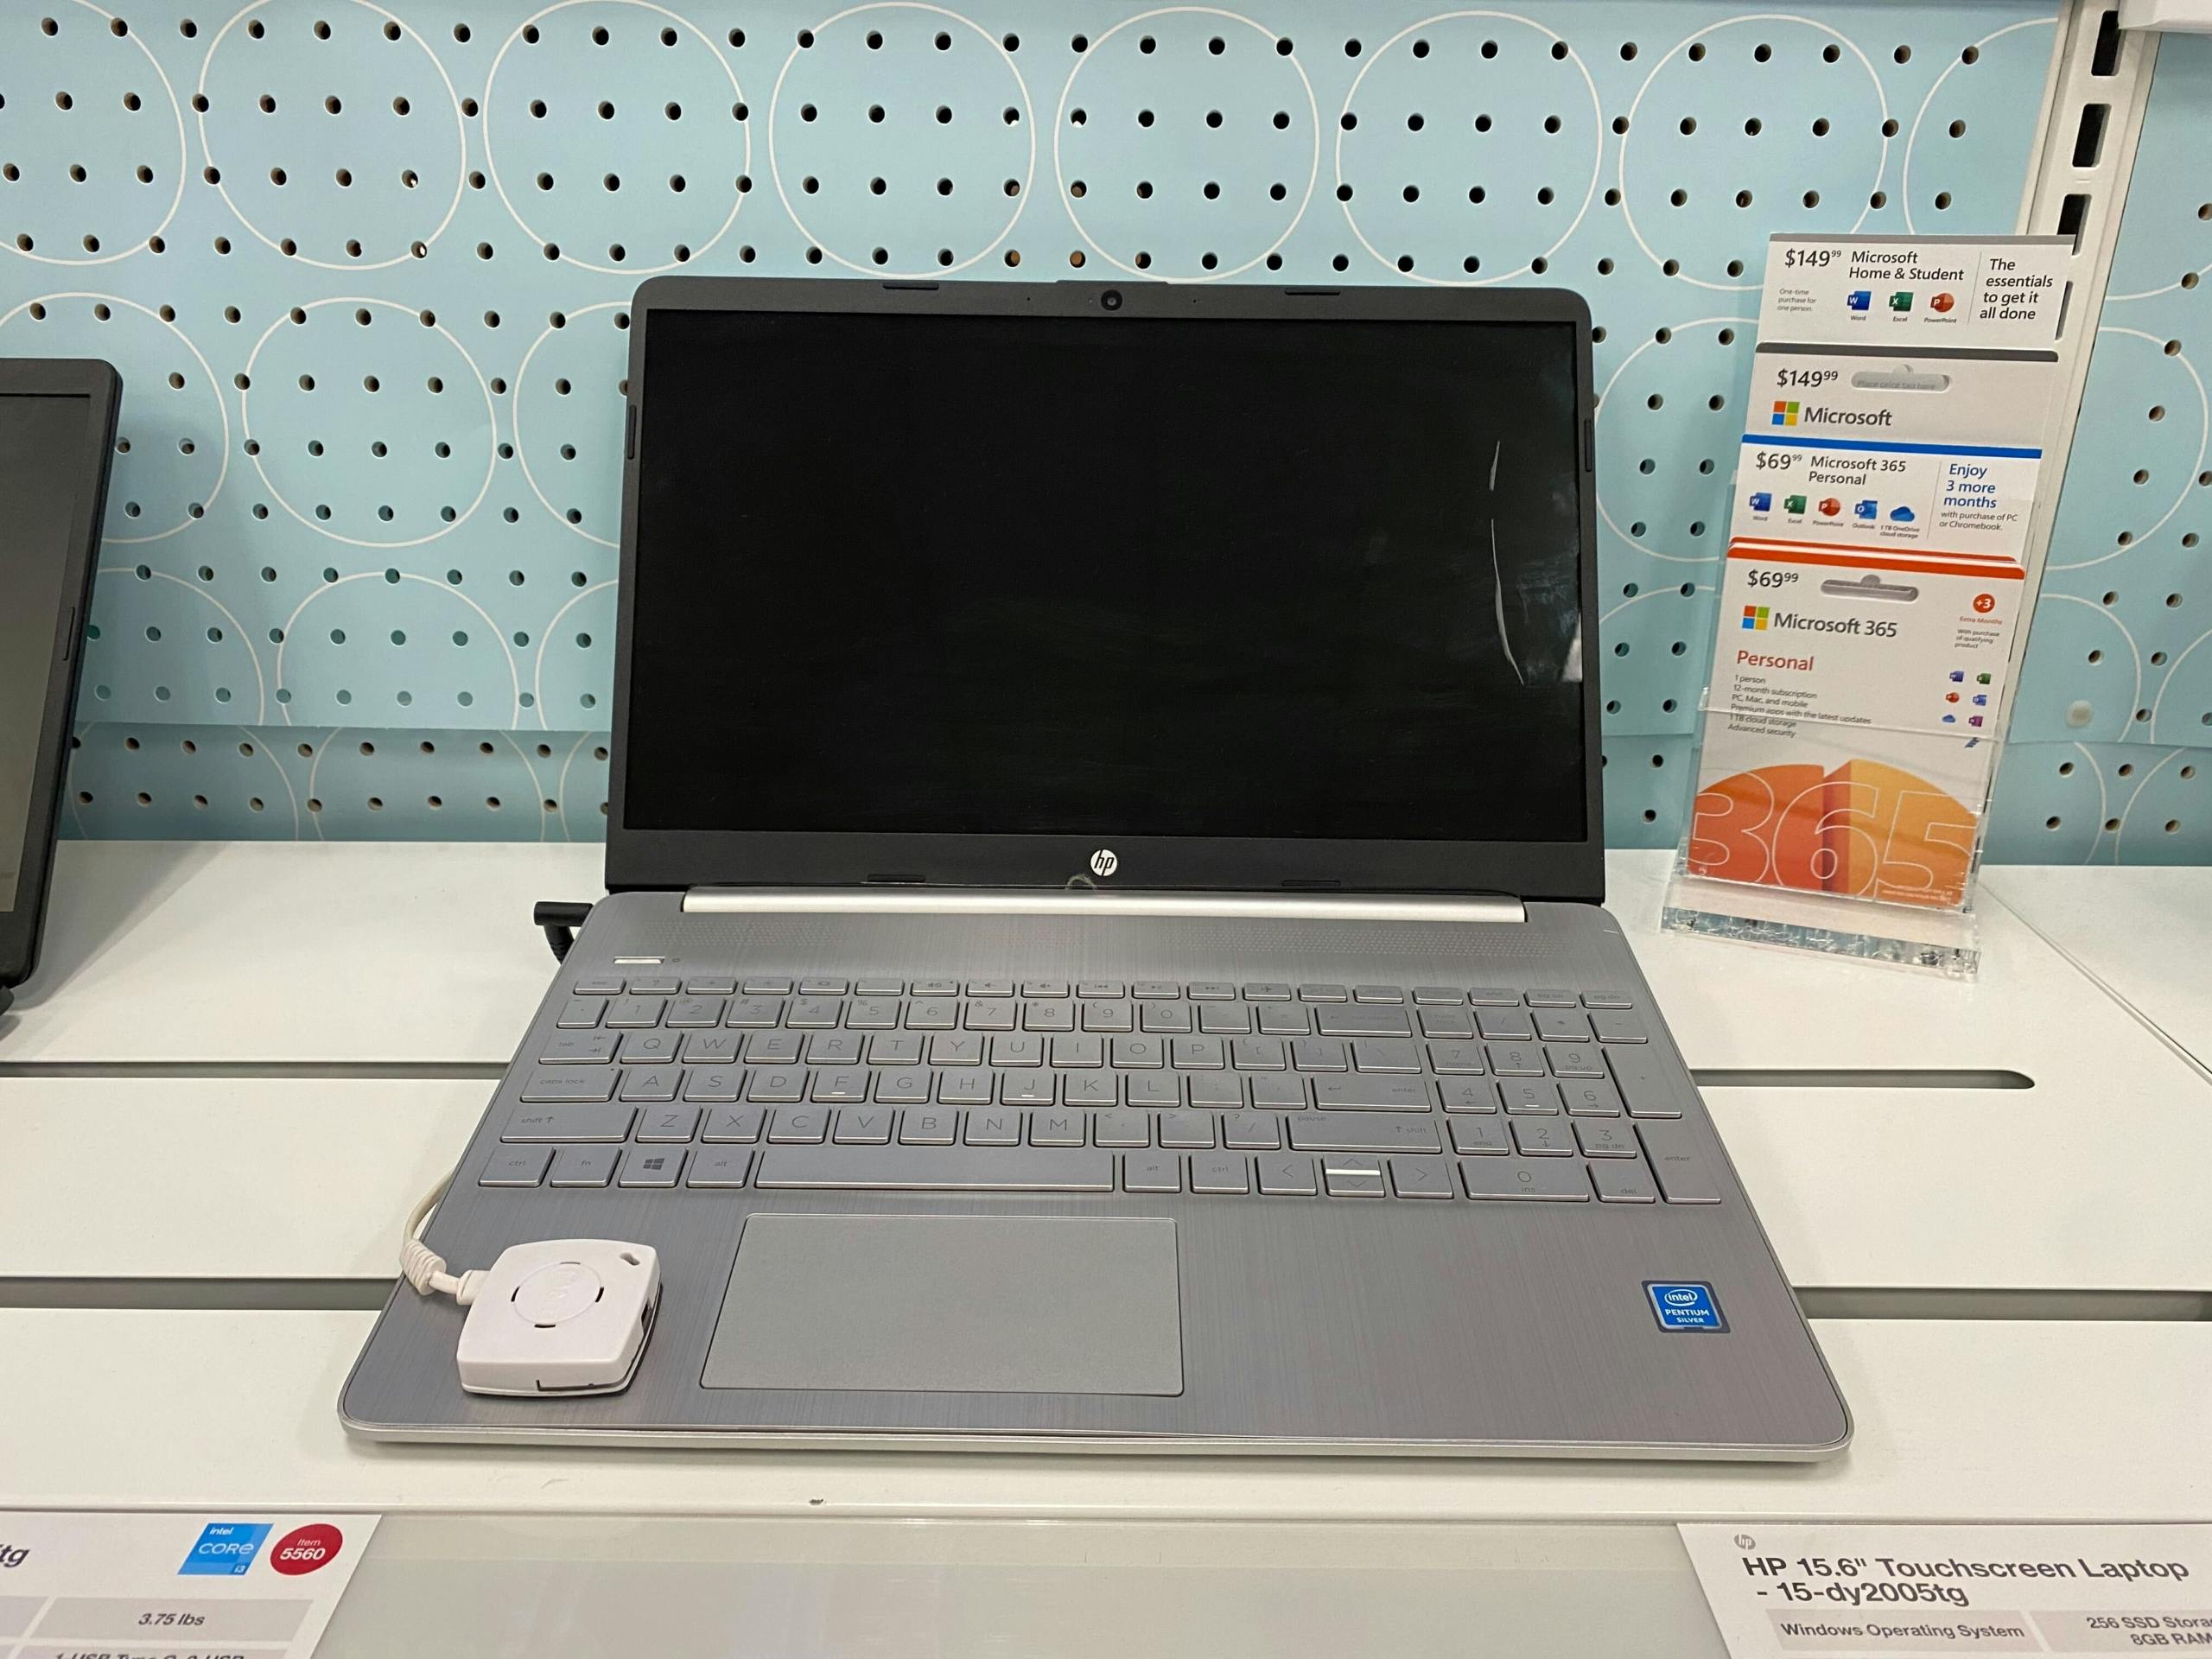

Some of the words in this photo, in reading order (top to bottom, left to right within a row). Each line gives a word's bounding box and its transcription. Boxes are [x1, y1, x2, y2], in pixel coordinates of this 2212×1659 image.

[1852, 251, 1918, 264] Microsoft
[1990, 258, 2016, 270] The
[1849, 267, 1891, 279] Home
[1894, 268, 1905, 279] &
[1909, 268, 1964, 281] Student
[1986, 275, 2053, 288] essentials
[1983, 292, 1999, 303] to
[2002, 293, 2025, 307] get
[2029, 292, 2039, 303] it
[1980, 308, 1996, 319] all
[1999, 308, 2036, 320] done
[1804, 407, 1892, 426] Microsoft
[1810, 455, 1878, 471] Microsoft
[1880, 460, 1906, 472] 365
[1949, 463, 1987, 479] Enjoy
[1808, 471, 1866, 486] Personal
[1947, 480, 1955, 492] 3
[1959, 483, 1996, 493] more
[1943, 497, 1997, 509] months
[1960, 512, 1995, 522] purchase
[1949, 521, 2003, 531] Chromebook.
[1976, 598, 1992, 608] +3
[1774, 613, 1860, 634] Microsoft
[1865, 620, 1897, 638] 365
[1737, 650, 1814, 671] Personal
[1733, 684, 1770, 694] 12-month
[1771, 688, 1817, 699] subscription
[1781, 699, 1808, 708] mobile
[1731, 703, 1764, 713] Premium
[1766, 708, 1784, 716] apps
[1818, 712, 1839, 721] latest
[1840, 715, 1872, 724] updates
[1745, 715, 1767, 724] cloud
[1768, 719, 1797, 728] storage
[1727, 724, 1765, 734] Advanced
[1766, 728, 1796, 738] security
[1688, 772, 1978, 901] 365
[1093, 849, 1116, 876] hp
[689, 1005, 702, 1014] 2
[749, 1005, 762, 1014] 3
[809, 1005, 821, 1014] 4
[868, 1007, 879, 1015] 5
[926, 1007, 939, 1016] 6
[987, 1007, 997, 1016] 7
[1044, 1008, 1056, 1018] 8
[1103, 1008, 1113, 1018] 9
[643, 1038, 661, 1050] Q
[703, 1039, 726, 1050] W
[767, 1039, 782, 1050] E
[827, 1039, 843, 1051] R
[891, 1040, 906, 1051] T
[950, 1040, 965, 1052] Y
[1010, 1041, 1025, 1052] U
[1129, 1043, 1147, 1054] O
[1192, 1044, 1205, 1055] P
[642, 1076, 660, 1087] A
[708, 1076, 723, 1087] S
[769, 1076, 786, 1087] D
[834, 1076, 849, 1087] F
[897, 1077, 913, 1089] G
[959, 1077, 976, 1090] H
[1023, 1079, 1035, 1090] J
[1084, 1080, 1098, 1091] K
[1147, 1080, 1160, 1092] L
[660, 1115, 678, 1128] Z
[727, 1115, 744, 1128] X
[791, 1116, 809, 1128] C
[858, 1116, 874, 1128] V
[922, 1117, 937, 1129] B
[987, 1118, 1001, 1130] N
[1050, 1118, 1067, 1131] M
[1667, 1292, 1694, 1301] intel
[209, 1527, 234, 1535] intel
[297, 1537, 321, 1547] Item
[1735, 1534, 1755, 1550] hp
[0, 1544, 30, 1567] tg
[279, 1548, 327, 1560] 5560
[1742, 1557, 1787, 1576] HP
[1797, 1558, 1867, 1577] 15.6"
[1875, 1558, 2077, 1578] Touchscreen
[2077, 1558, 2190, 1582] Laptop
[1777, 1582, 1970, 1606] 15-dy2005tg
[138, 1613, 175, 1626] 3.75
[178, 1612, 206, 1626] lbs
[2086, 1617, 2120, 1629] 256
[2121, 1617, 2160, 1629] SSD
[2163, 1617, 2212, 1628] Stora
[1781, 1623, 1863, 1637] Windows
[1866, 1624, 1956, 1639] Operating
[1957, 1624, 2024, 1638] System
[2130, 1633, 2170, 1645] 8GB
[2171, 1632, 2212, 1644] RAM
